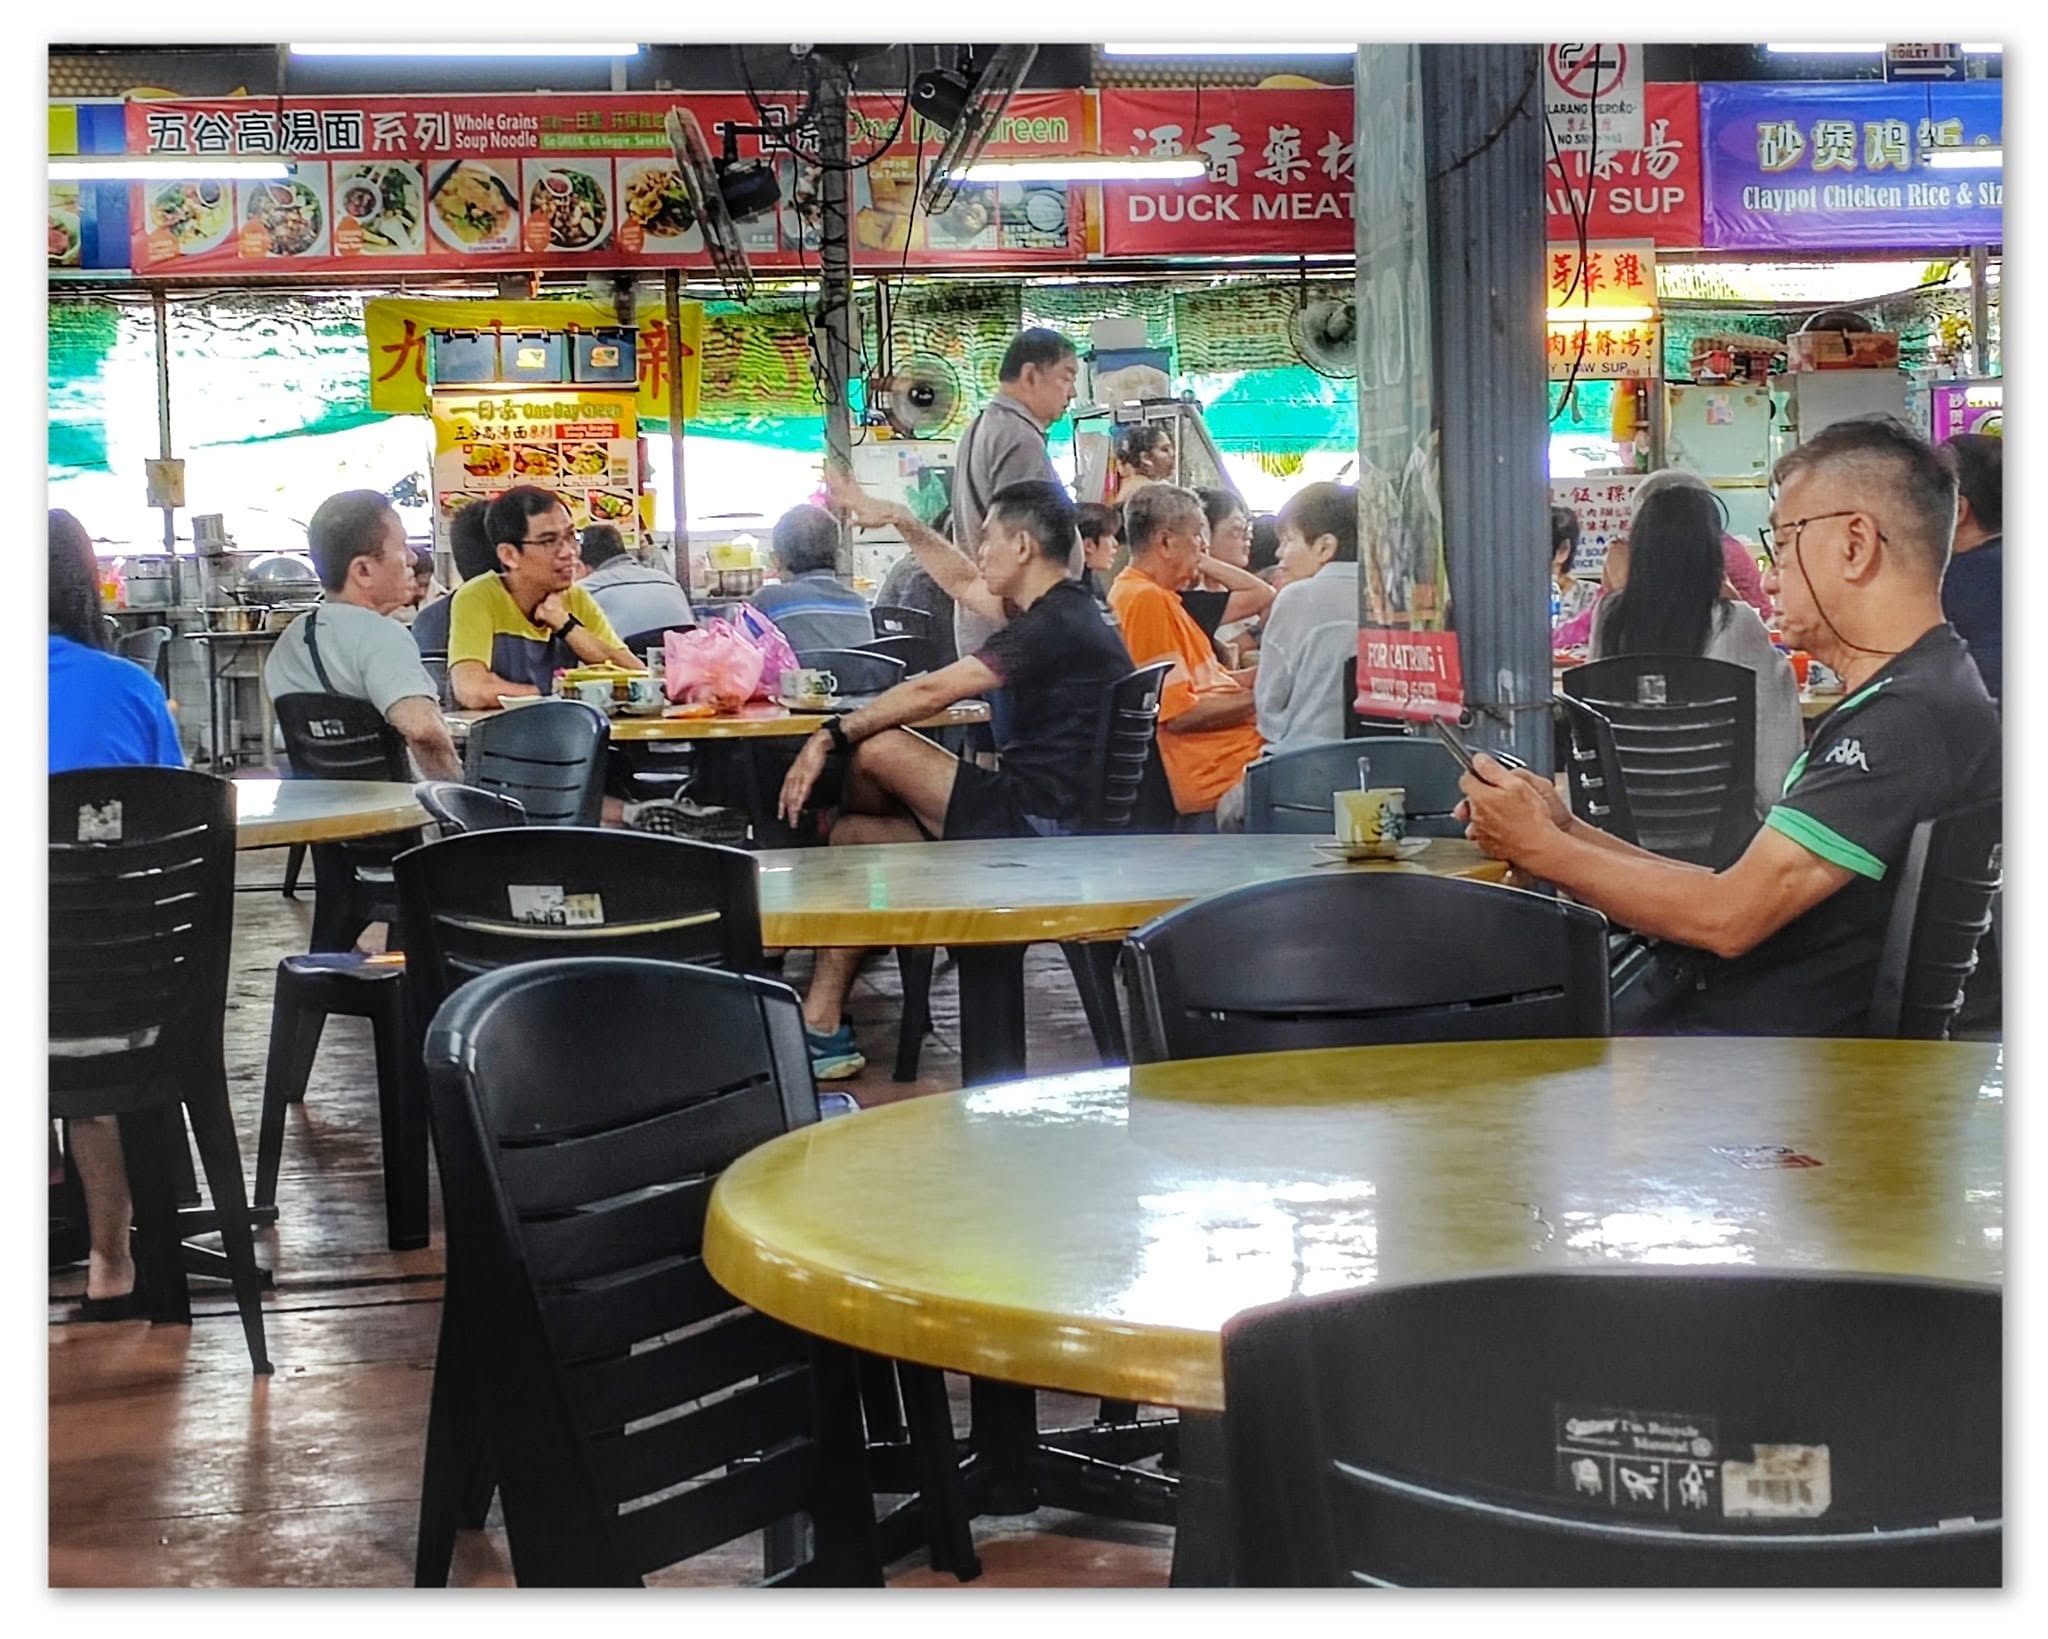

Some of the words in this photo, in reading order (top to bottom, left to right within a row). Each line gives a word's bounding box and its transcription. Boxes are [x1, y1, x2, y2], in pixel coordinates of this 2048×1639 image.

[452, 112, 493, 131] Whole
[496, 113, 538, 131] Grains
[455, 132, 489, 153] Soup
[490, 131, 538, 149] Noodle
[1558, 134, 1573, 145] NO
[1128, 193, 1241, 222] DUCK
[1608, 186, 1685, 215] SUP
[1743, 184, 1817, 214] Claypot
[1824, 183, 1902, 208] Chicken
[1907, 182, 1951, 206] Rice
[1956, 183, 1973, 205] &
[1601, 361, 1628, 373] SUP
[523, 402, 550, 419] One
[553, 402, 580, 422] Day
[1367, 642, 1388, 669] FOR
